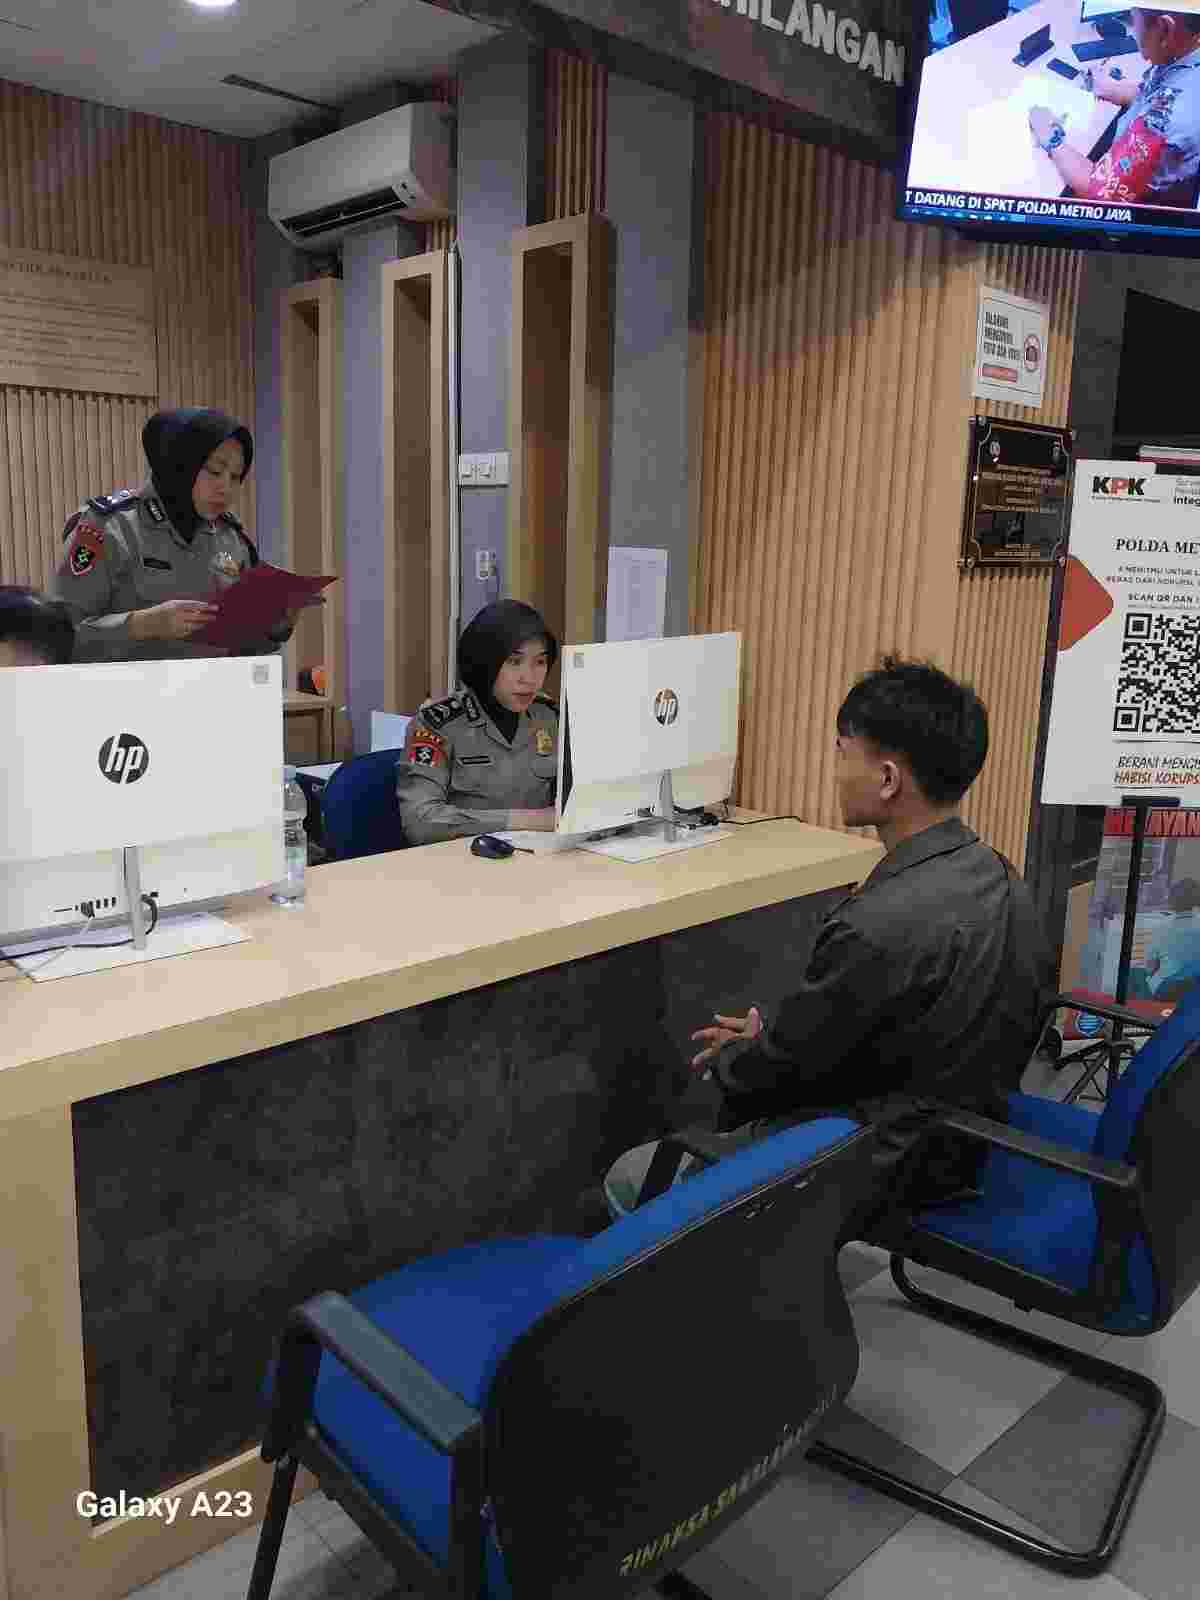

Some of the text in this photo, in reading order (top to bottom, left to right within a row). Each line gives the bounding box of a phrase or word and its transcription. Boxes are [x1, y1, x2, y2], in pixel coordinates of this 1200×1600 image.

[719, 0, 905, 86] LANGAN
[915, 191, 965, 207] DATANG
[968, 196, 981, 208] DI
[984, 197, 1014, 212] SPKT
[1016, 201, 1057, 215] POLDA
[1060, 205, 1103, 219] METRO
[1105, 208, 1132, 221] JAYA
[1093, 476, 1146, 495] KPK
[1115, 538, 1169, 552] POLDA
[100, 733, 148, 784] hp
[1118, 756, 1159, 769] BERANI
[1114, 771, 1152, 784] HABISI
